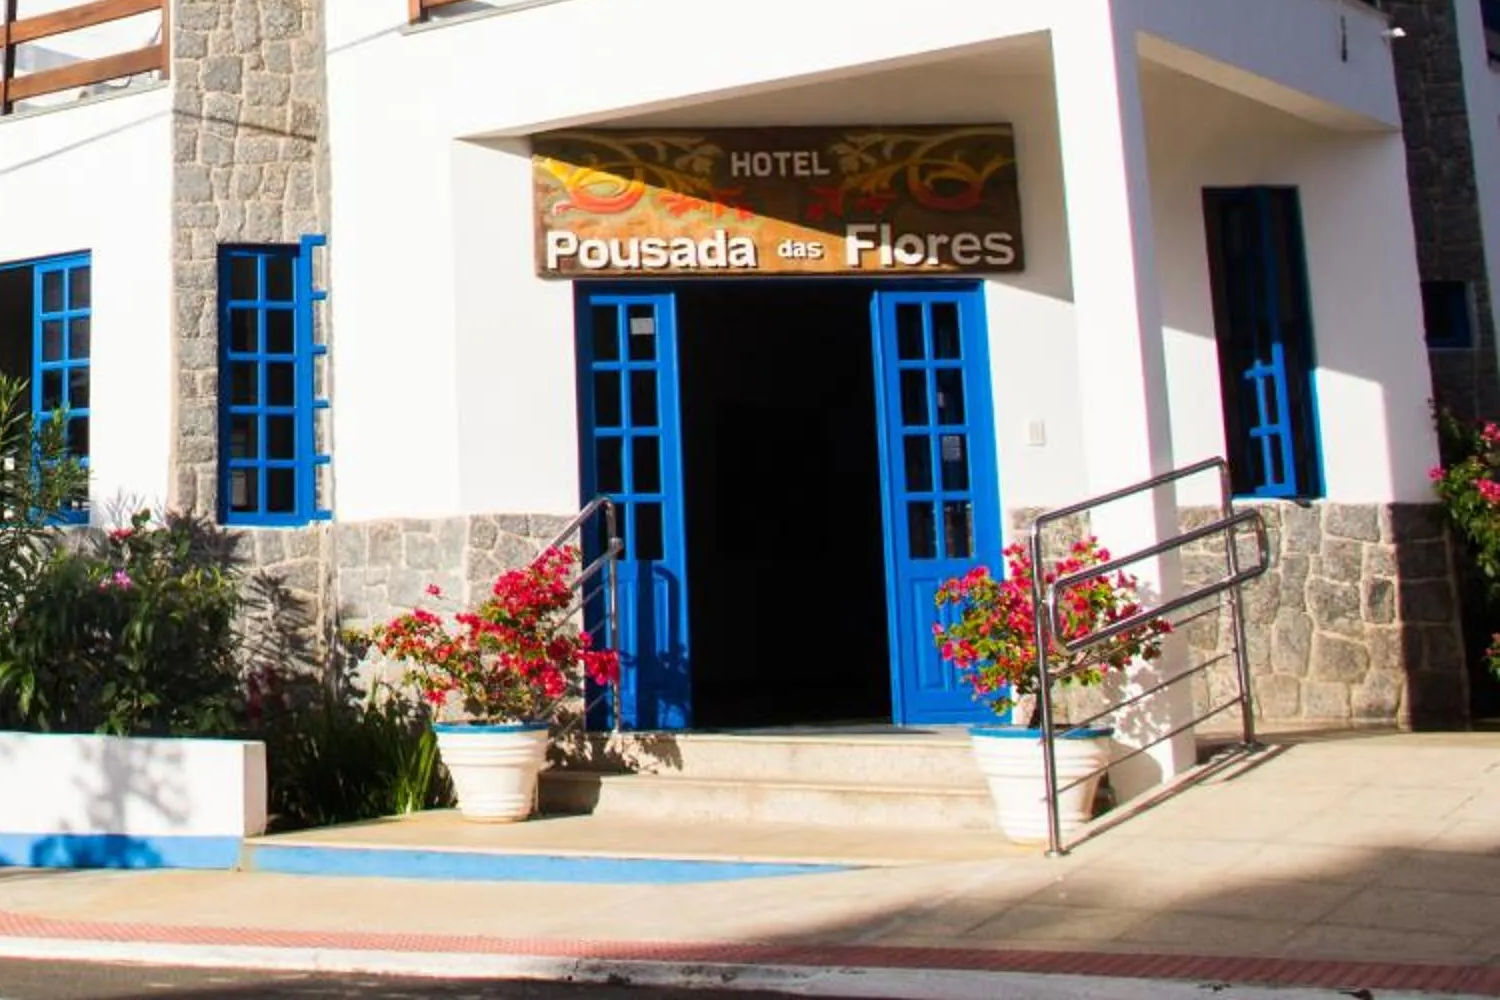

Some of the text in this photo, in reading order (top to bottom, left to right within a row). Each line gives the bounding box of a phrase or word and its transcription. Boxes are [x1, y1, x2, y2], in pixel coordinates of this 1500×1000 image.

[731, 151, 830, 177] HOTEL
[547, 224, 1015, 269] Pousada das Flores
